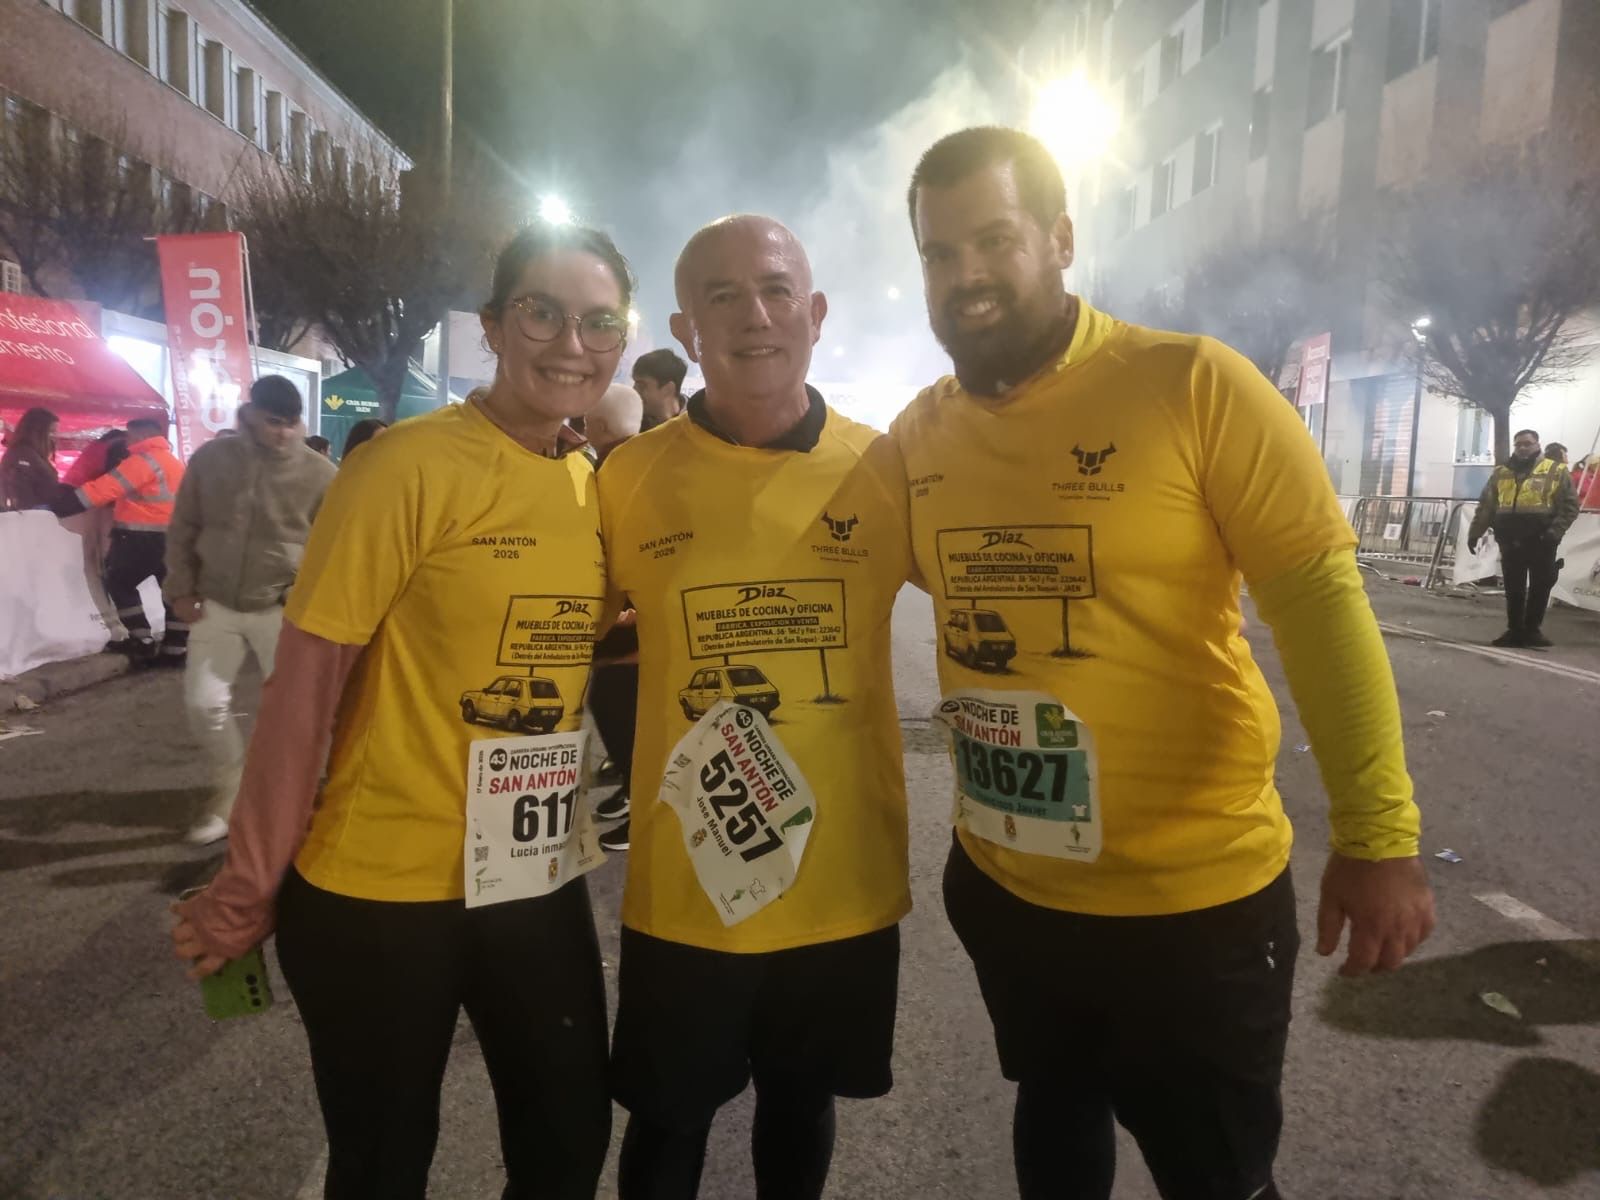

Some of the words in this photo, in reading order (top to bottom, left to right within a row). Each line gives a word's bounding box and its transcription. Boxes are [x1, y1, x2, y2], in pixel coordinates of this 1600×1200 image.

[1052, 482, 1086, 491] THREE
[1088, 482, 1125, 492] BULLS
[471, 536, 497, 546] SAN
[500, 535, 537, 547] ANTÓN
[639, 540, 657, 553] SAN
[810, 545, 841, 555] THREE
[841, 546, 869, 557] BULLS
[493, 549, 520, 559] 2026
[653, 546, 675, 559] 2026
[948, 553, 981, 562] MUEBLES
[983, 553, 993, 562] DE
[994, 552, 1025, 562] COCINA
[1034, 552, 1075, 563] OFICINA
[696, 608, 737, 622] MUEBLES
[739, 607, 750, 617] DE
[752, 605, 788, 617] COCINA
[789, 606, 795, 616] y
[797, 603, 833, 614] OFICINA
[516, 620, 550, 630] MUEBLES
[552, 620, 560, 630] DE
[561, 620, 584, 630] COCINA
[961, 701, 997, 723] NOCHE
[1000, 708, 1020, 725] DE
[953, 715, 974, 733] SAN
[975, 725, 1021, 747] ANTÓN
[509, 751, 558, 771] NOCHE
[561, 749, 578, 765] DE
[720, 723, 746, 758] SAN
[737, 759, 779, 813] ANTÓN
[743, 730, 781, 780] NOCHE
[772, 779, 794, 801] DE
[959, 739, 1069, 803] 13627
[489, 775, 522, 795] SAN
[526, 766, 577, 791] ANTÓN
[512, 789, 580, 843] 611
[700, 749, 784, 863] 5257
[707, 818, 732, 857] Manuel
